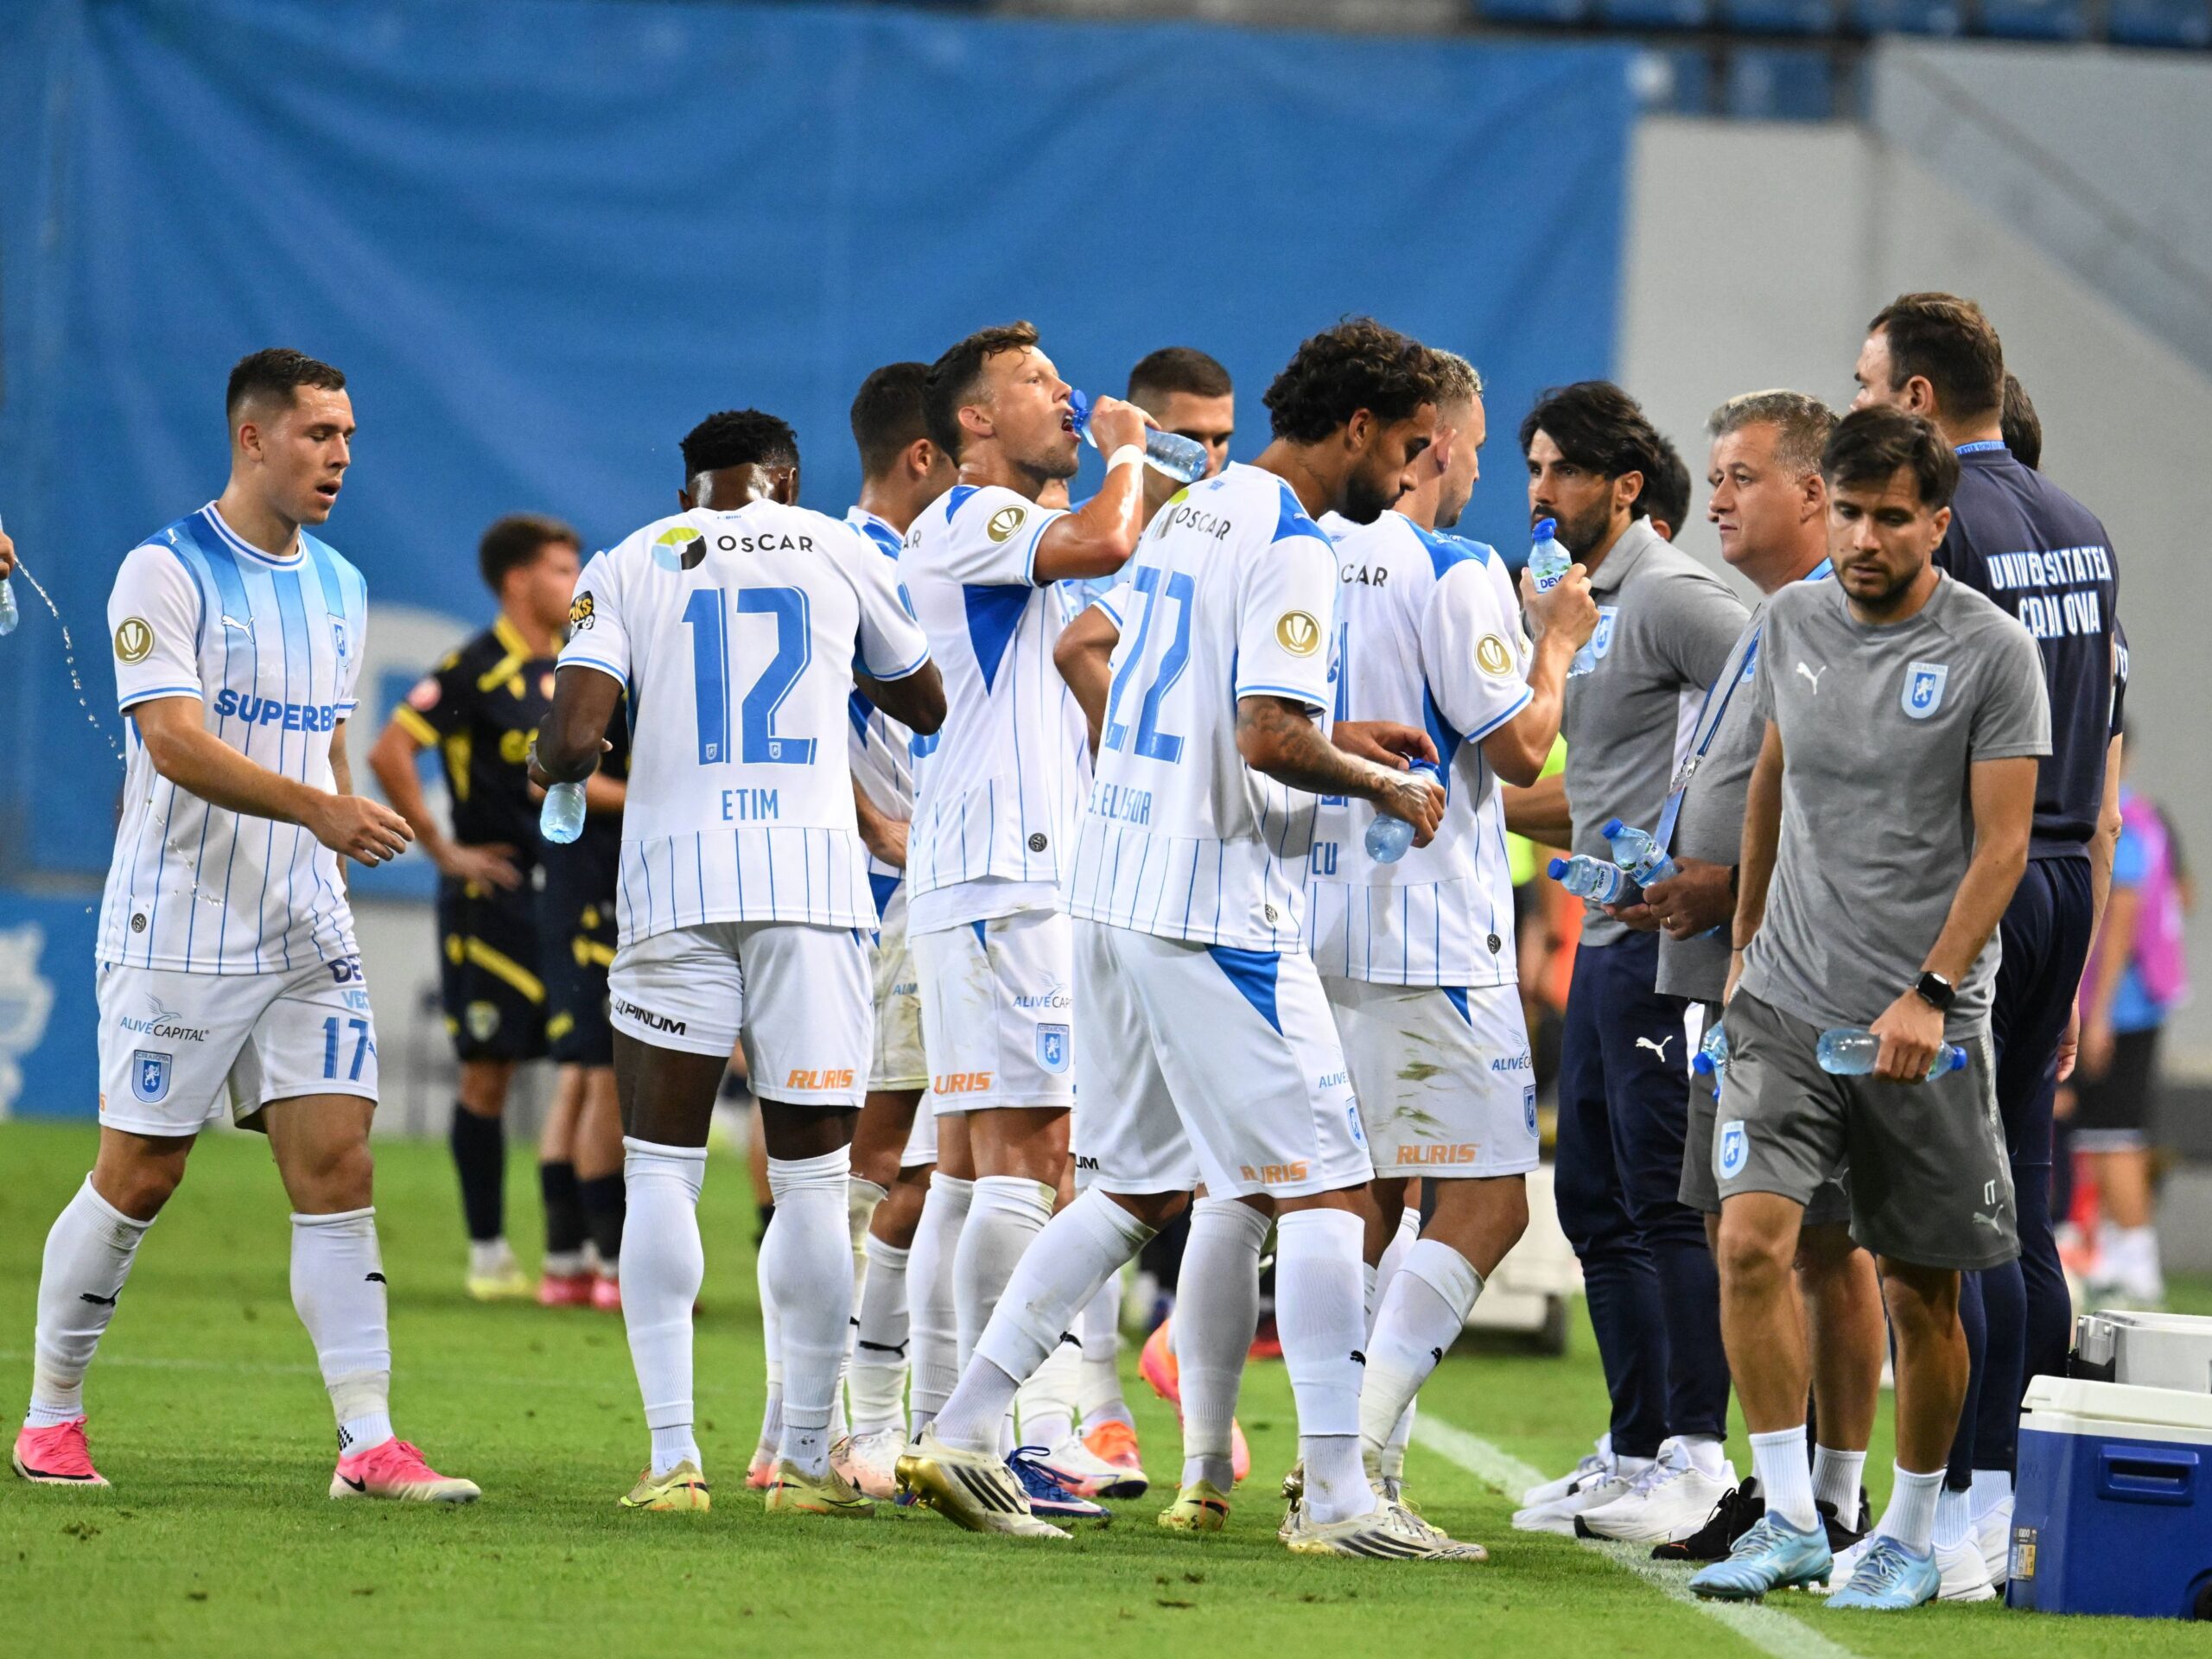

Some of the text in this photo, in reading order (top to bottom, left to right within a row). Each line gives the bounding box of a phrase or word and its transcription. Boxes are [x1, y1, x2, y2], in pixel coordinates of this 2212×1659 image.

[1176, 507, 1230, 540] OSCAR
[717, 533, 813, 552] OSCAR
[1341, 563, 1388, 588] CAR
[682, 586, 817, 765] 12
[1105, 565, 1198, 764] 22
[722, 789, 779, 820] ETIM
[1313, 842, 1338, 874] CU
[322, 1017, 368, 1082] 17
[786, 1069, 854, 1090] RURIS
[934, 1071, 995, 1095] URIS
[1396, 1143, 1480, 1164] RURIS
